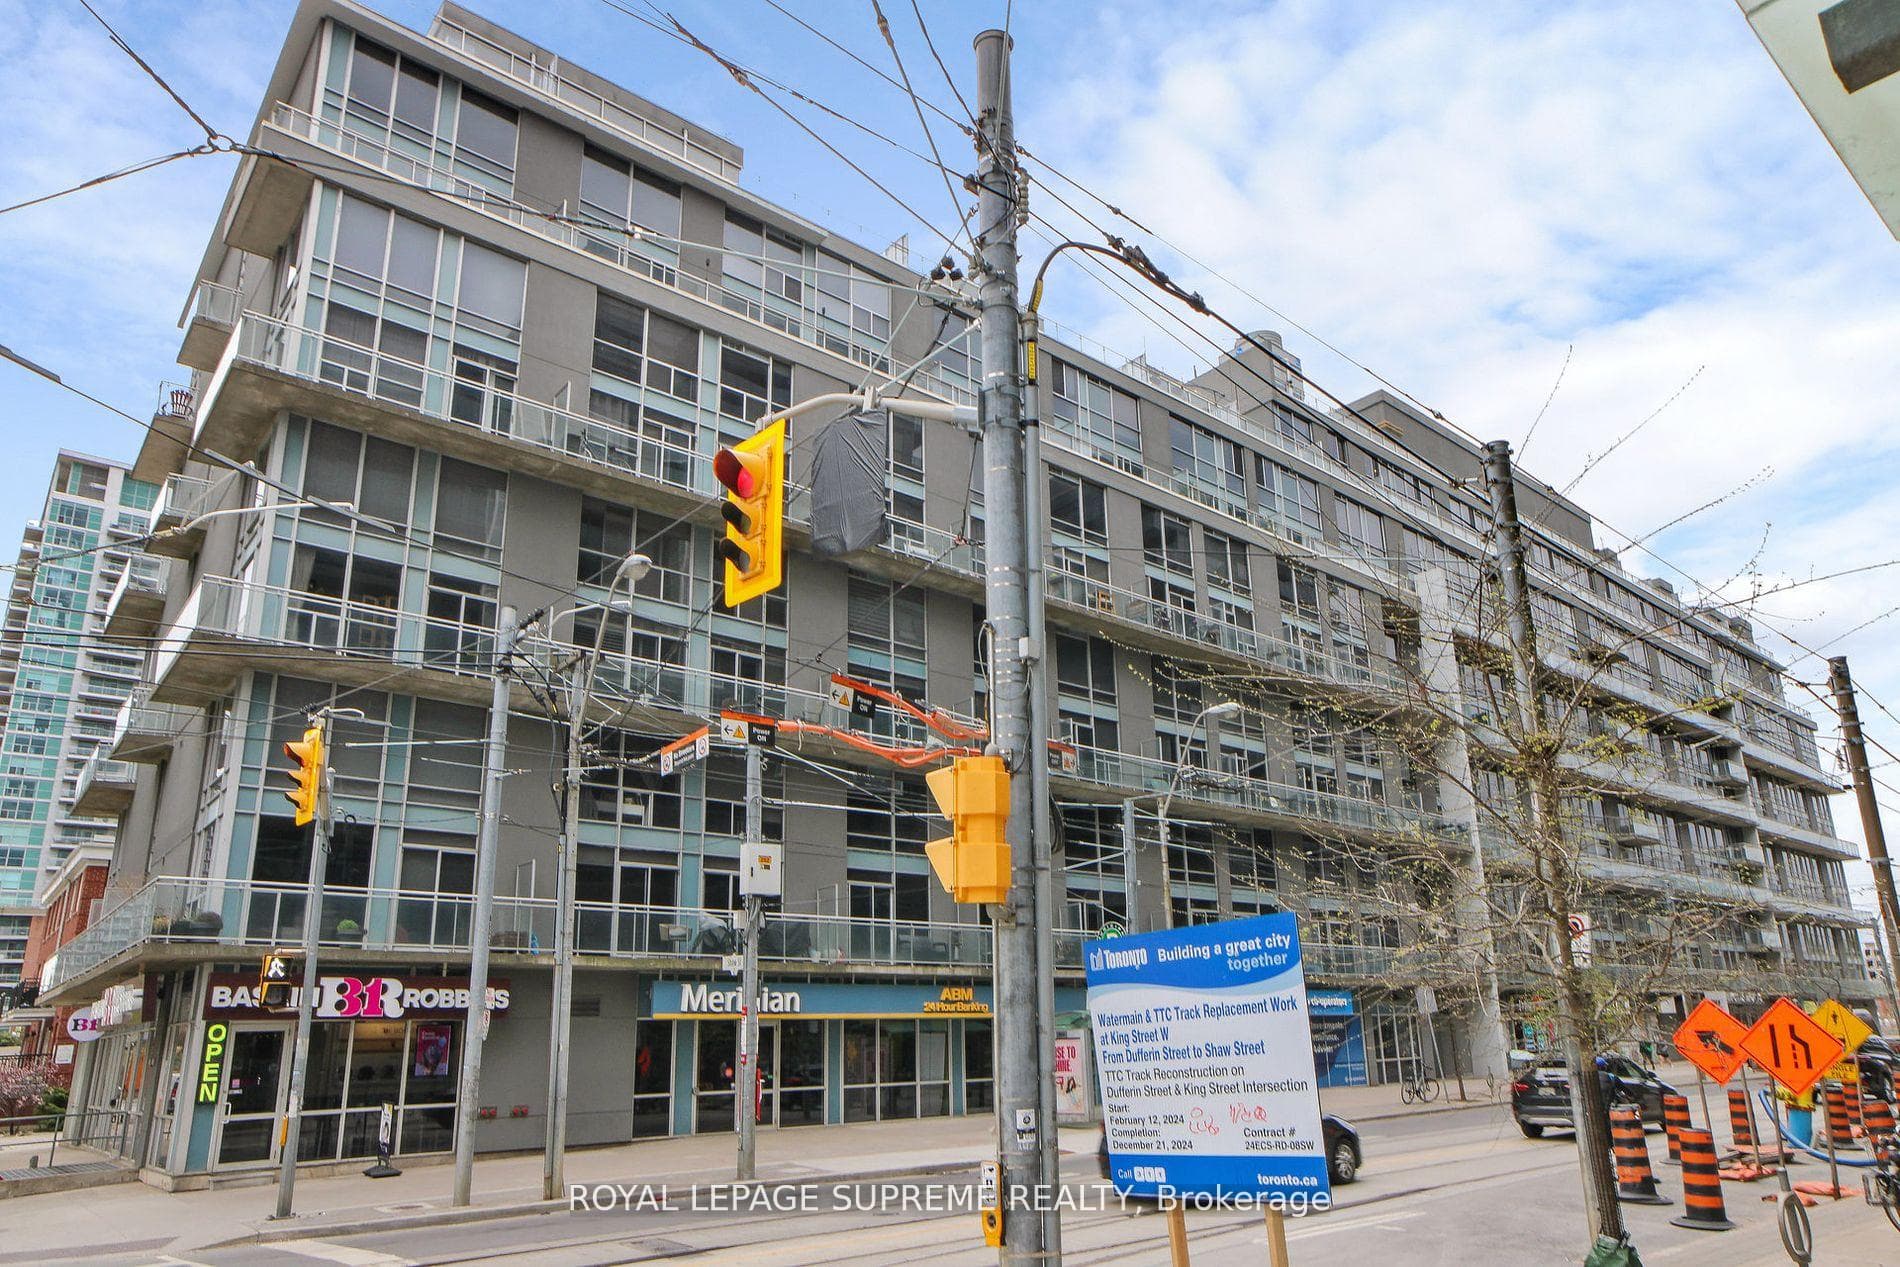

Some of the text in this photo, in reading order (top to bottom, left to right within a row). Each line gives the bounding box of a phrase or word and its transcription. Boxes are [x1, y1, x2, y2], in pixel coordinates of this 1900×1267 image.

[1158, 933, 1291, 962] Building a great city
[1227, 951, 1288, 972] together
[402, 987, 510, 1009] ROBBS
[680, 983, 800, 1013] Meriian
[940, 987, 973, 1001] ABM
[937, 1002, 956, 1012] Hour
[957, 1001, 989, 1014] Banking
[1097, 996, 1298, 1027] Watermain & TTC Track Replacement Work
[1100, 1027, 1169, 1047] at King Street W
[1102, 1040, 1265, 1064] From Dufferin Street to Shaw Street
[199, 1023, 227, 1103] OPEN
[1105, 1065, 1245, 1083] TTC Track Reconstruction on
[1106, 1078, 1308, 1099] Dufferin Street & King Street Intersection
[1108, 1103, 1130, 1113] Start:
[1110, 1114, 1185, 1127] February 12, 2024
[1111, 1128, 1161, 1139] Completion:
[1243, 1127, 1296, 1138] Contract #
[1113, 1140, 1193, 1151] December 21, 2024
[1117, 1168, 1132, 1179] Call
[1257, 1172, 1318, 1187] toronto.ca
